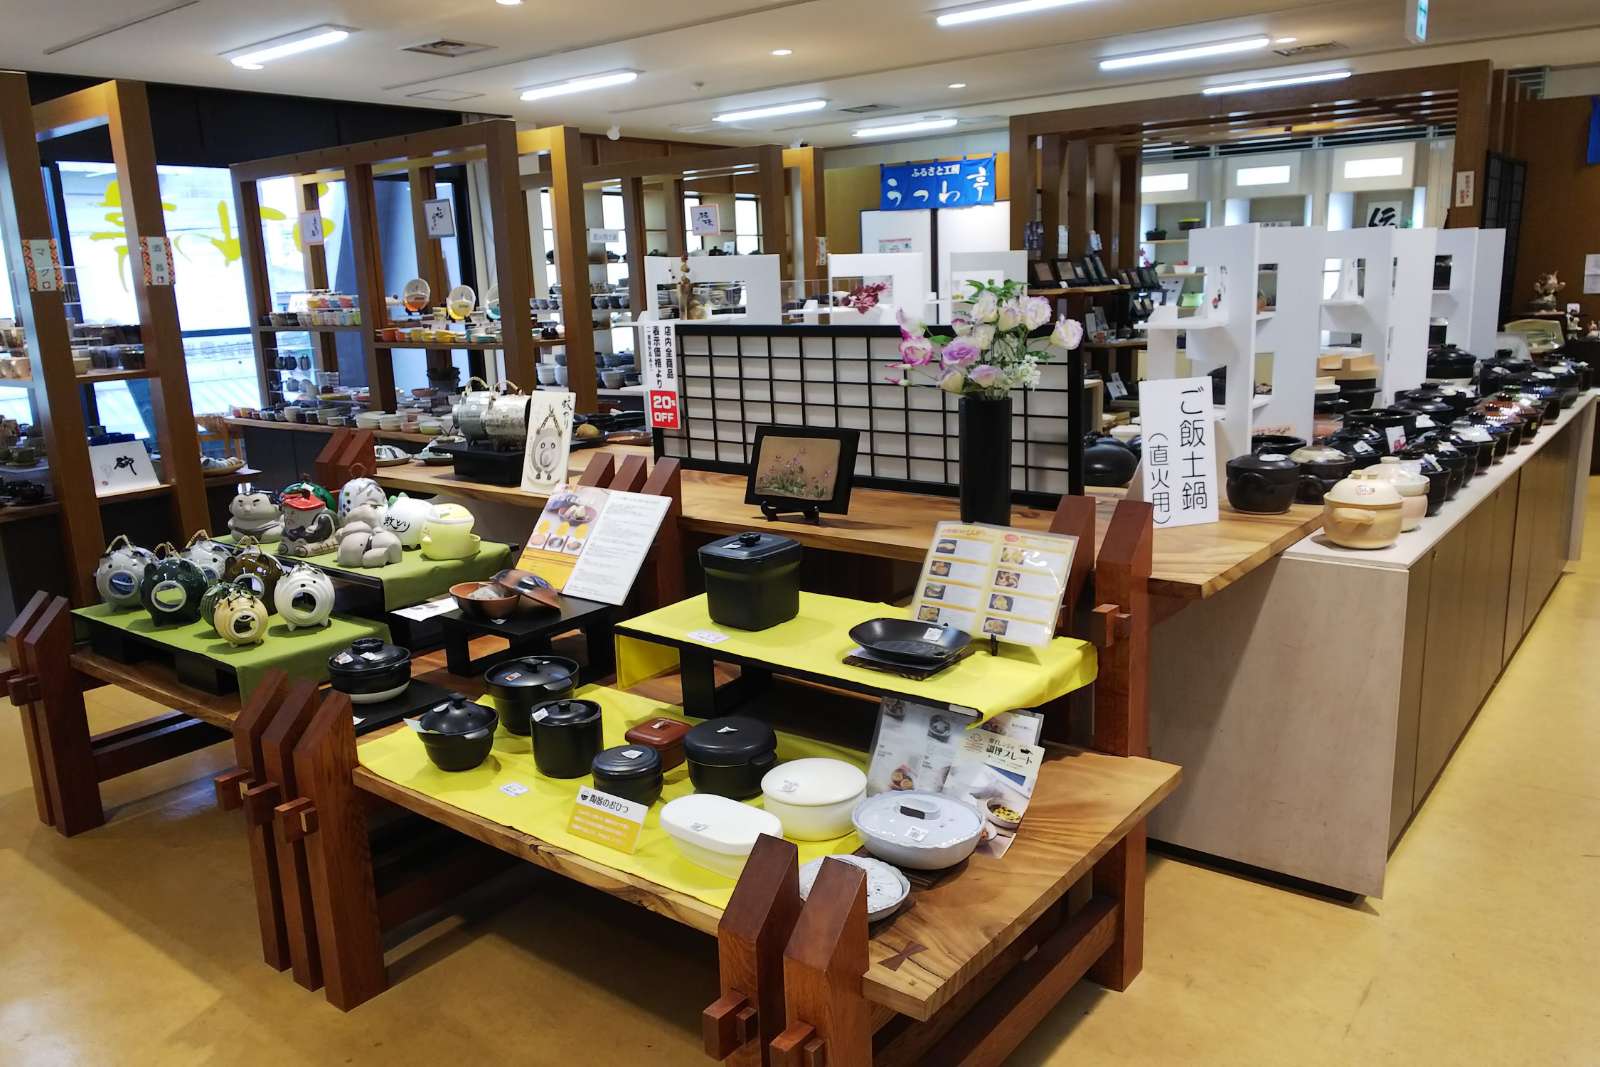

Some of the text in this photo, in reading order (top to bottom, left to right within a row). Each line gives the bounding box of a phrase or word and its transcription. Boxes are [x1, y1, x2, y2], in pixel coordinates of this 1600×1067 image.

[911, 164, 961, 177] ふるさと工房
[886, 166, 990, 207] うつわ亭
[652, 325, 663, 389] 表示価格より
[664, 325, 675, 379] 店内全商品
[654, 412, 674, 423] OFF
[1179, 385, 1208, 511] ご飯土鍋
[986, 744, 1033, 765] 調理プレート
[589, 793, 629, 814] 陶器のおひつ
